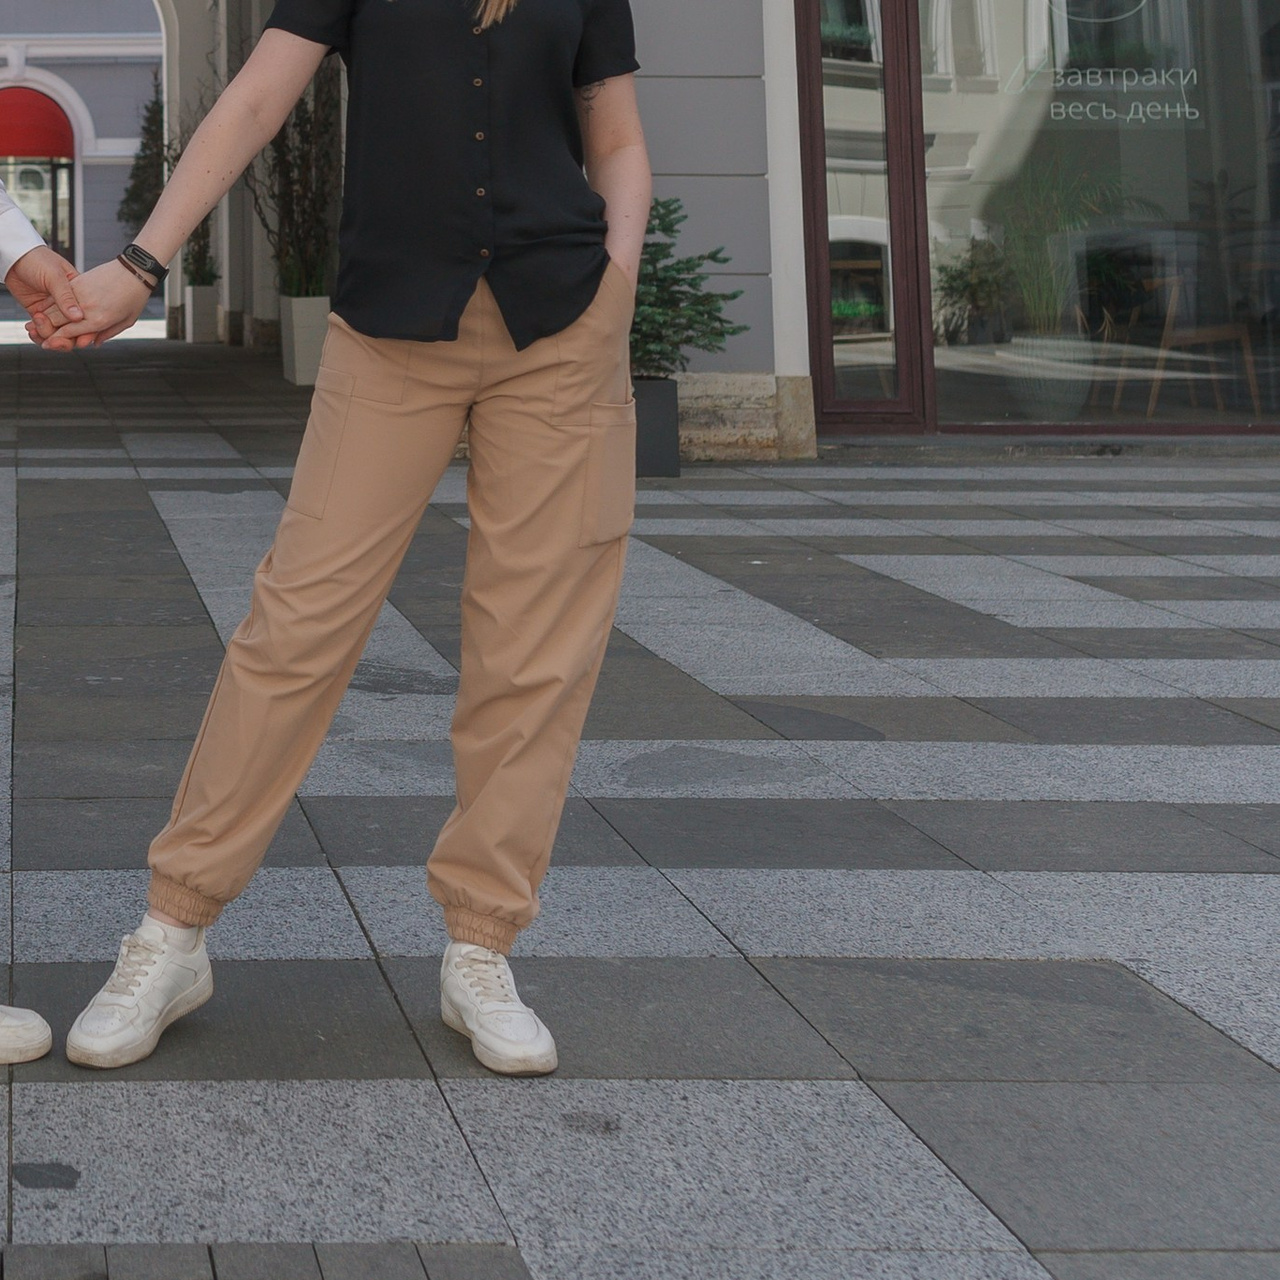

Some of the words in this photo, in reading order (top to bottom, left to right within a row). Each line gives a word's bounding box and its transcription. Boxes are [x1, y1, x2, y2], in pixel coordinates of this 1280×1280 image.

[1052, 67, 1198, 93] завтраки
[1050, 101, 1116, 120] весь
[1127, 101, 1200, 124] день
